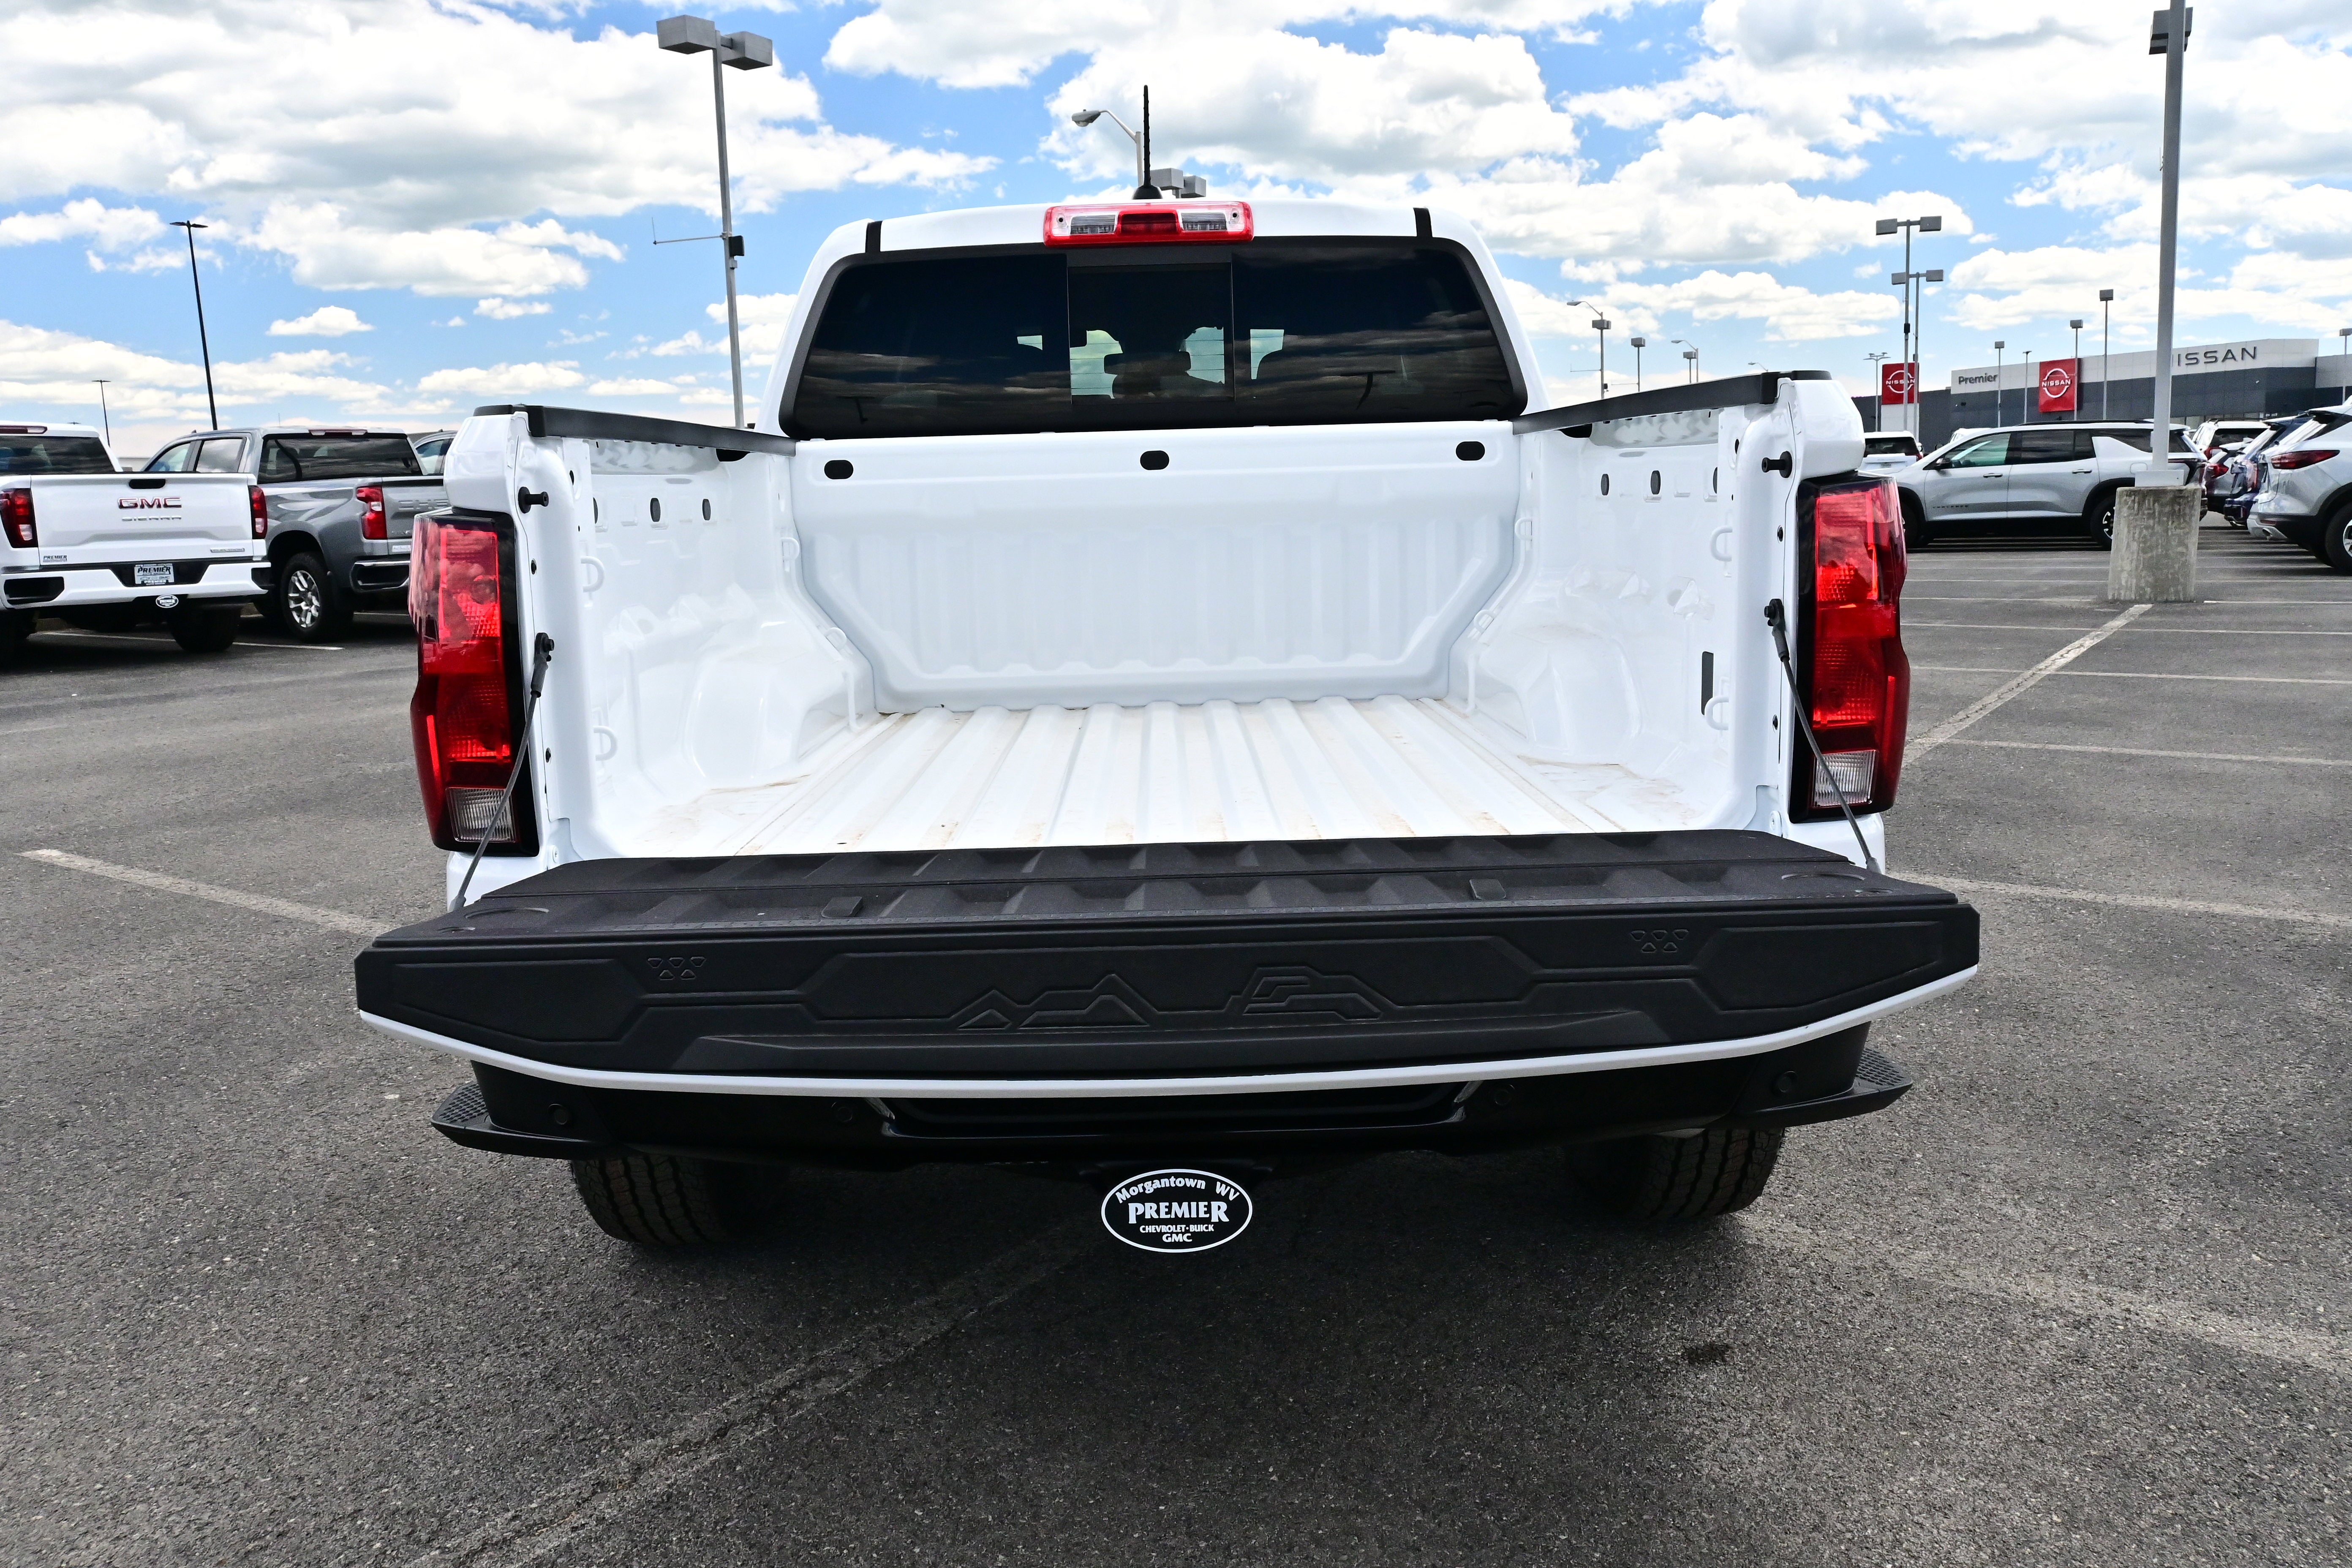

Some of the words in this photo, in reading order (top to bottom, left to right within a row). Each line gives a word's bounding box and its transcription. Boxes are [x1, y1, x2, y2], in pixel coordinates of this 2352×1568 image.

[2171, 346, 2257, 367] ISSAN
[1958, 373, 1998, 385] Premier
[118, 496, 182, 509] GMC
[137, 565, 171, 575] PREMIER
[1115, 1176, 1206, 1203] Morgantown
[1215, 1181, 1240, 1201] WV
[1128, 1201, 1230, 1224] PREMIER
[1162, 1233, 1192, 1243] GMC
